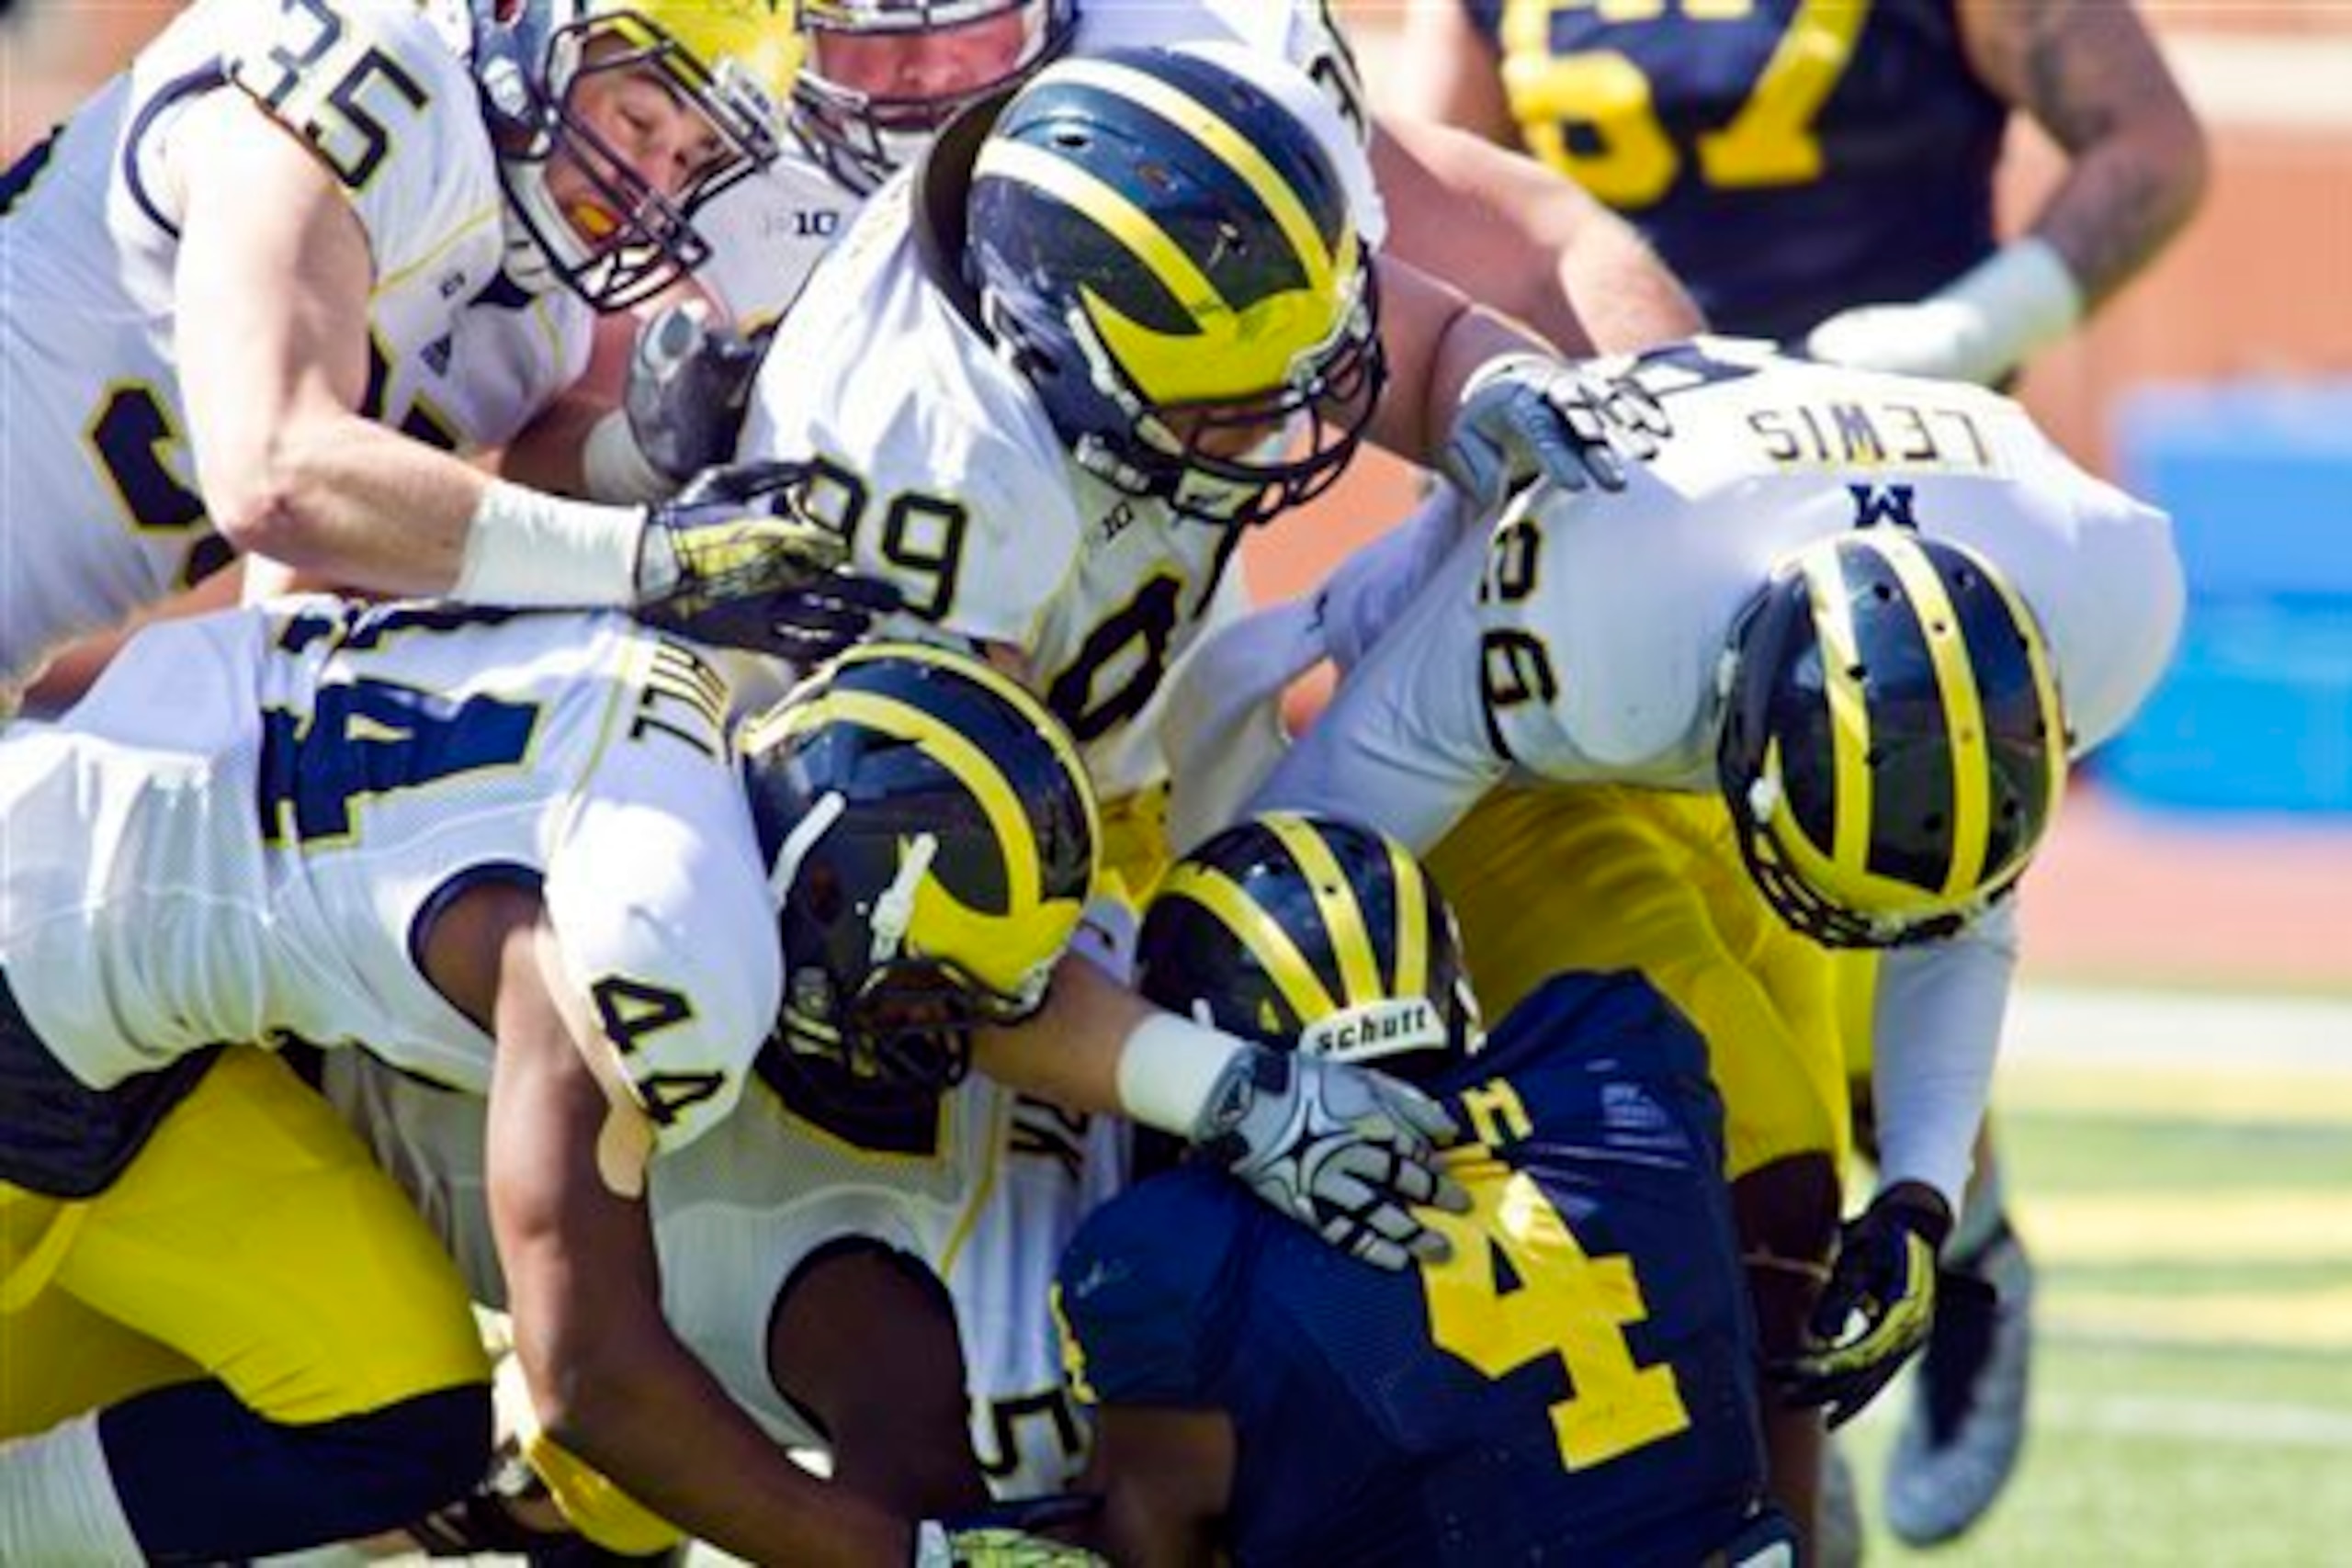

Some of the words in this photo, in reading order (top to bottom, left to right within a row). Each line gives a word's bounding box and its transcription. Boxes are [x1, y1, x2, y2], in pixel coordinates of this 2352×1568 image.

[1747, 401, 1990, 466] LEWIS
[1848, 483, 1918, 529] M
[1479, 520, 1559, 761] 26
[260, 606, 540, 841] 4
[592, 975, 725, 1126] 44
[1316, 1007, 1426, 1052] schutt
[1411, 1144, 1690, 1472] 4
